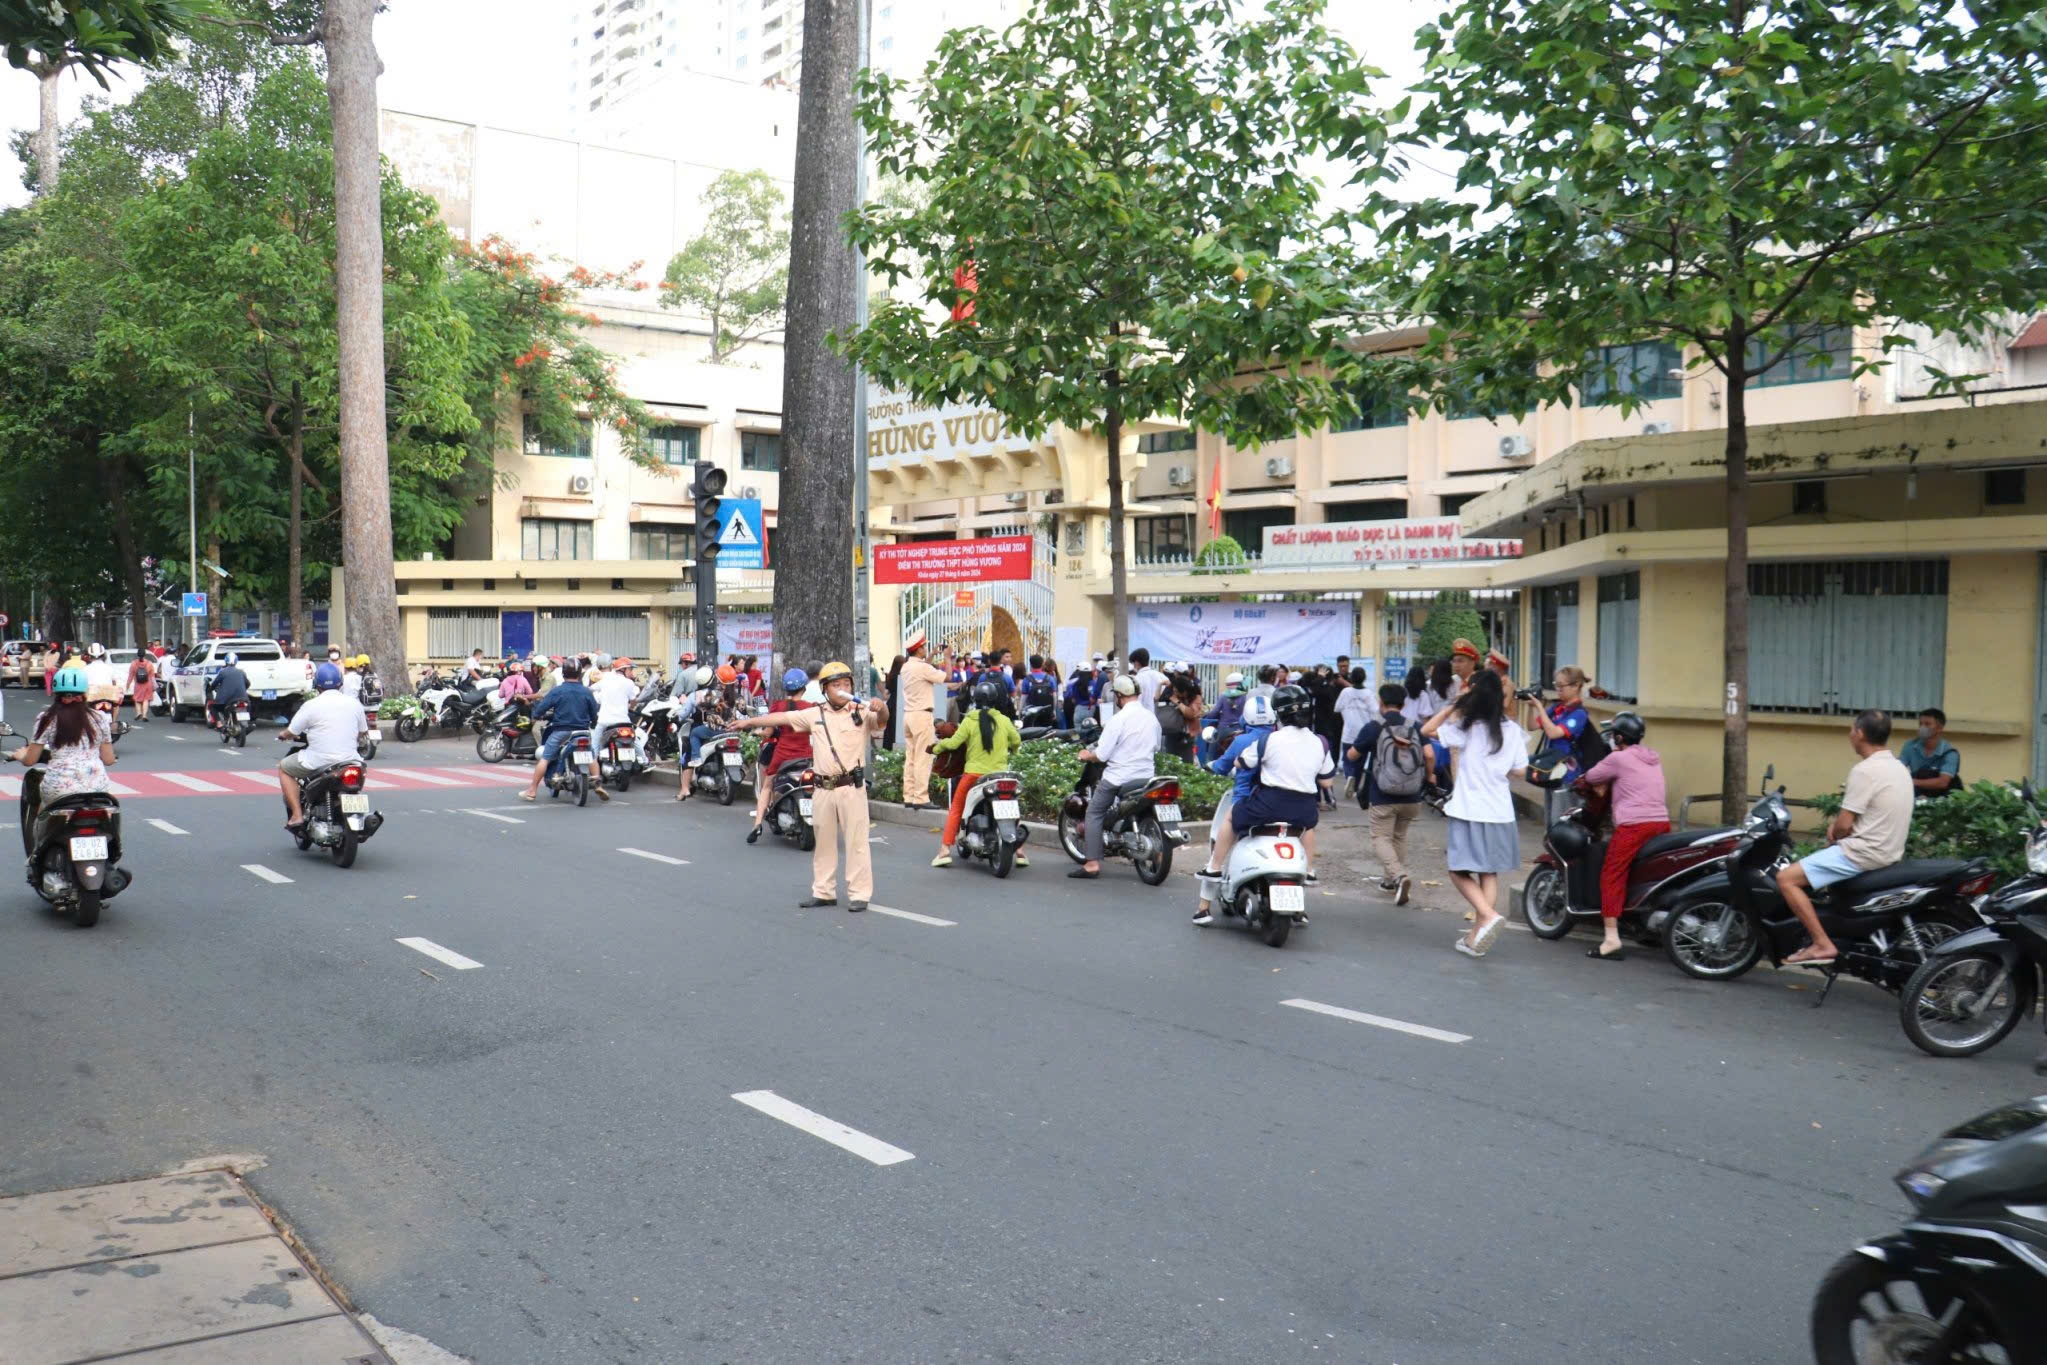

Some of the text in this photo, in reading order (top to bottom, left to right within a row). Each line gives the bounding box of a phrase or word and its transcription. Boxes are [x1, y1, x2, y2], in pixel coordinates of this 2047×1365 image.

[868, 400, 903, 420] RƯỜNG
[868, 409, 1021, 458] HÙNG VƯƠ
[1388, 525, 1401, 540] LÀ
